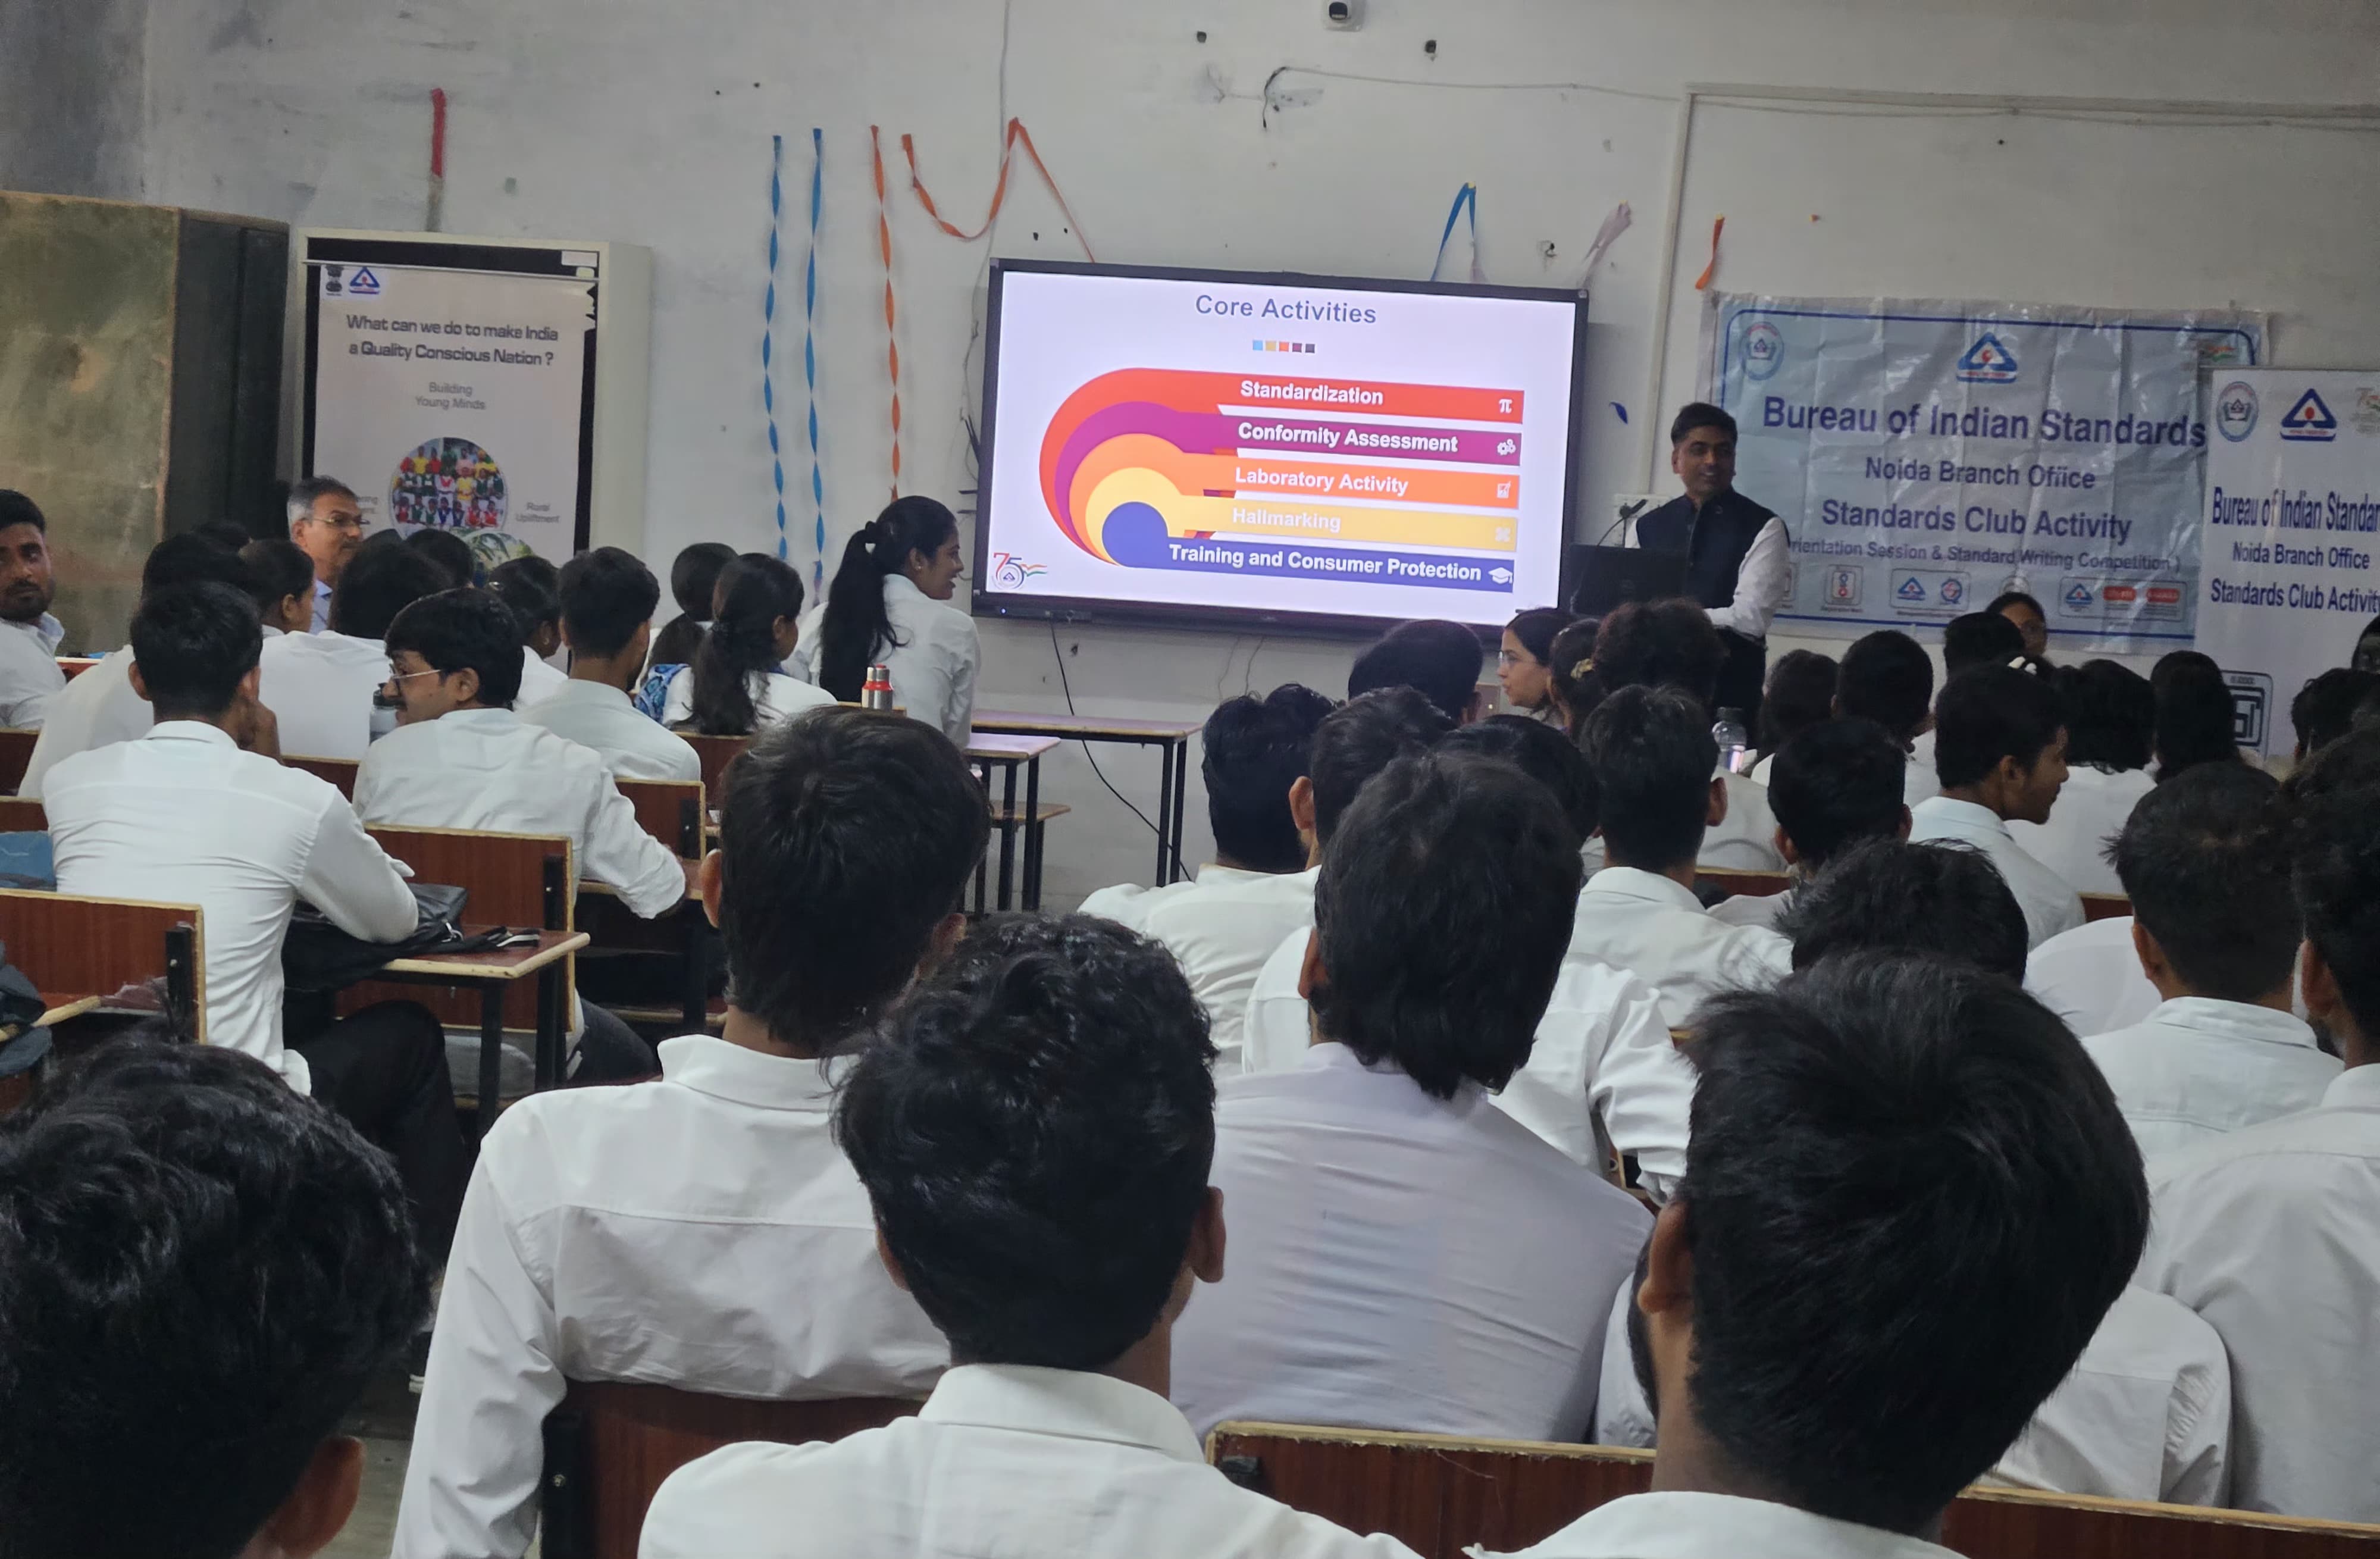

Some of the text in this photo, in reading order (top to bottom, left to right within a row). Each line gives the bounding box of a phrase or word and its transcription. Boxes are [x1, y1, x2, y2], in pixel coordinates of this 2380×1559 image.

[1196, 295, 1376, 323] Core Activities
[346, 314, 559, 342] What can we do to make India
[349, 341, 554, 366] a Quality Conscious Nation ?
[416, 395, 486, 411] Young Minds
[429, 381, 473, 397] Building
[1240, 380, 1384, 405] Standardization
[1764, 396, 2206, 447] Bureau of Indian Standards
[1238, 422, 1458, 453] Conformity Assessment
[1235, 467, 1408, 497] Laboratory Activity
[1865, 456, 2096, 489] Noida Branch Office
[1232, 508, 1341, 534] Hallmarking
[1821, 499, 2132, 546] Standards Club Activity
[2212, 486, 2380, 533] Bureau of Indian Standar
[1169, 543, 1482, 581] Training and Consumer Protection
[1789, 539, 1862, 556] rientation
[1866, 541, 1928, 560] Session
[1931, 544, 1943, 561] &
[1946, 545, 2015, 564] Standard
[2022, 548, 2074, 570] Writing
[2077, 552, 2171, 572] Competition
[2232, 541, 2370, 569] Noida Branch Office
[2210, 578, 2285, 606] Standards
[2288, 583, 2324, 609] Club
